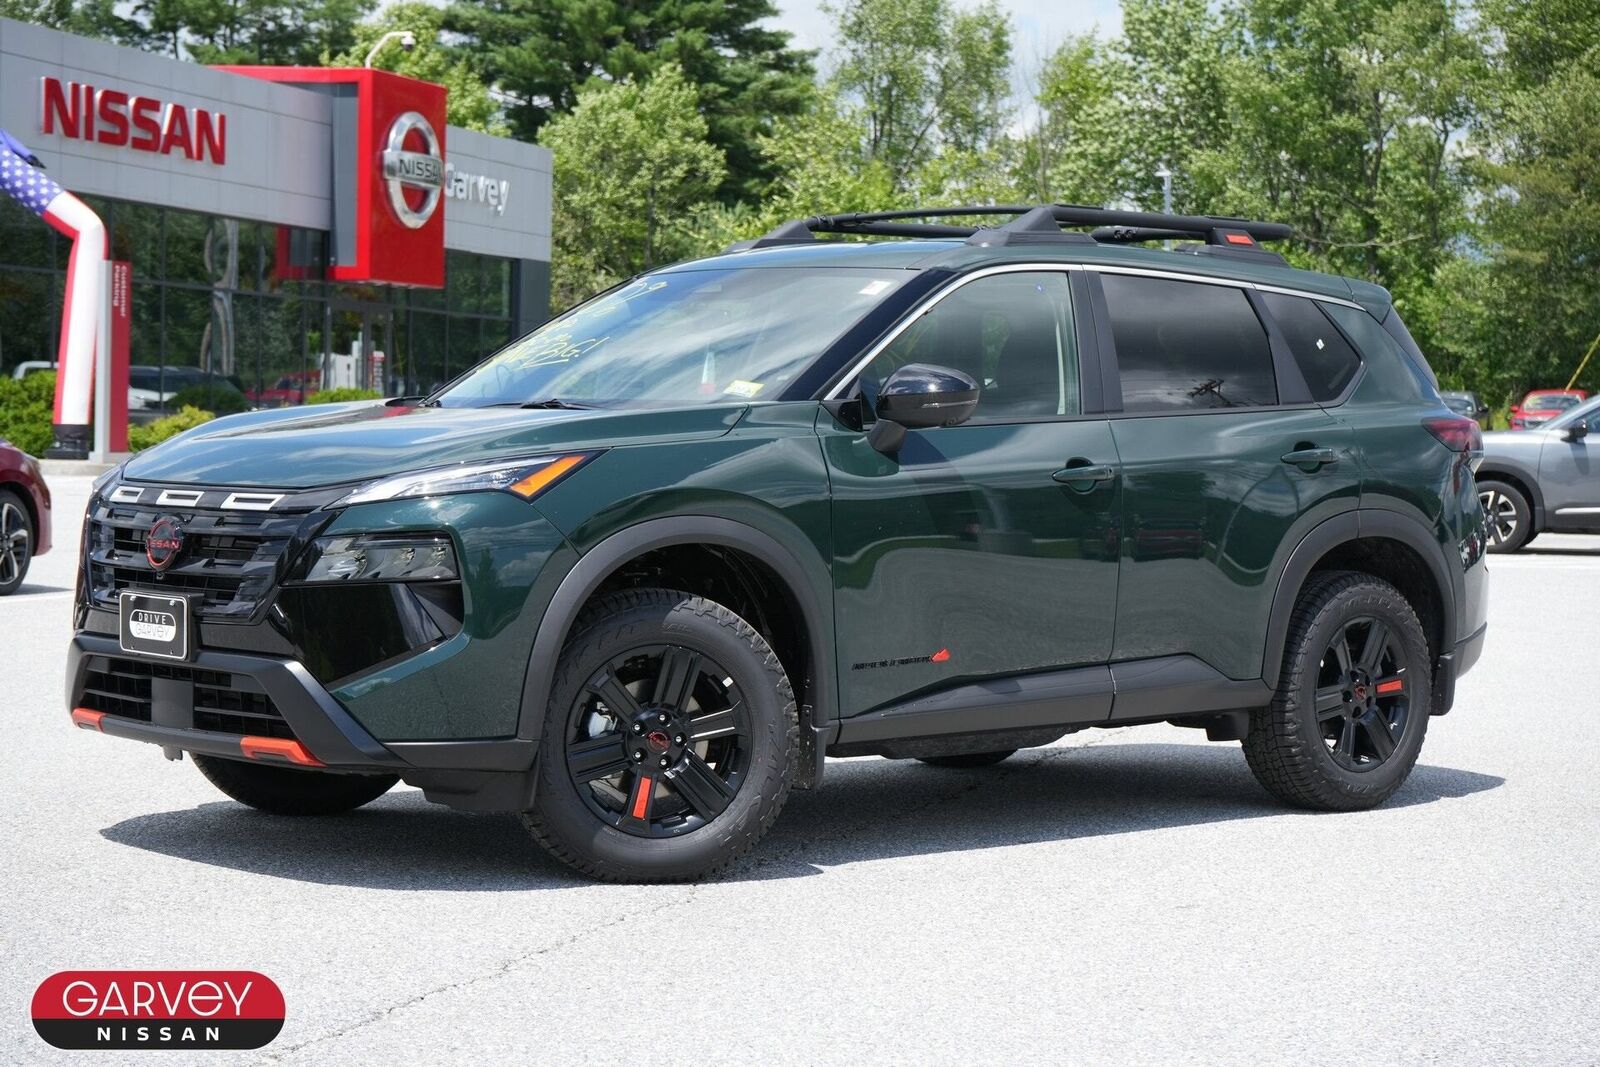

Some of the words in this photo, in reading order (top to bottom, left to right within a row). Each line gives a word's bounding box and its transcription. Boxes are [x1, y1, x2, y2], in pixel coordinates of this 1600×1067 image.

[41, 76, 226, 165] NISSAN
[399, 158, 441, 181] NISSA
[445, 162, 510, 216] Garvey
[138, 612, 167, 625] DRIVE
